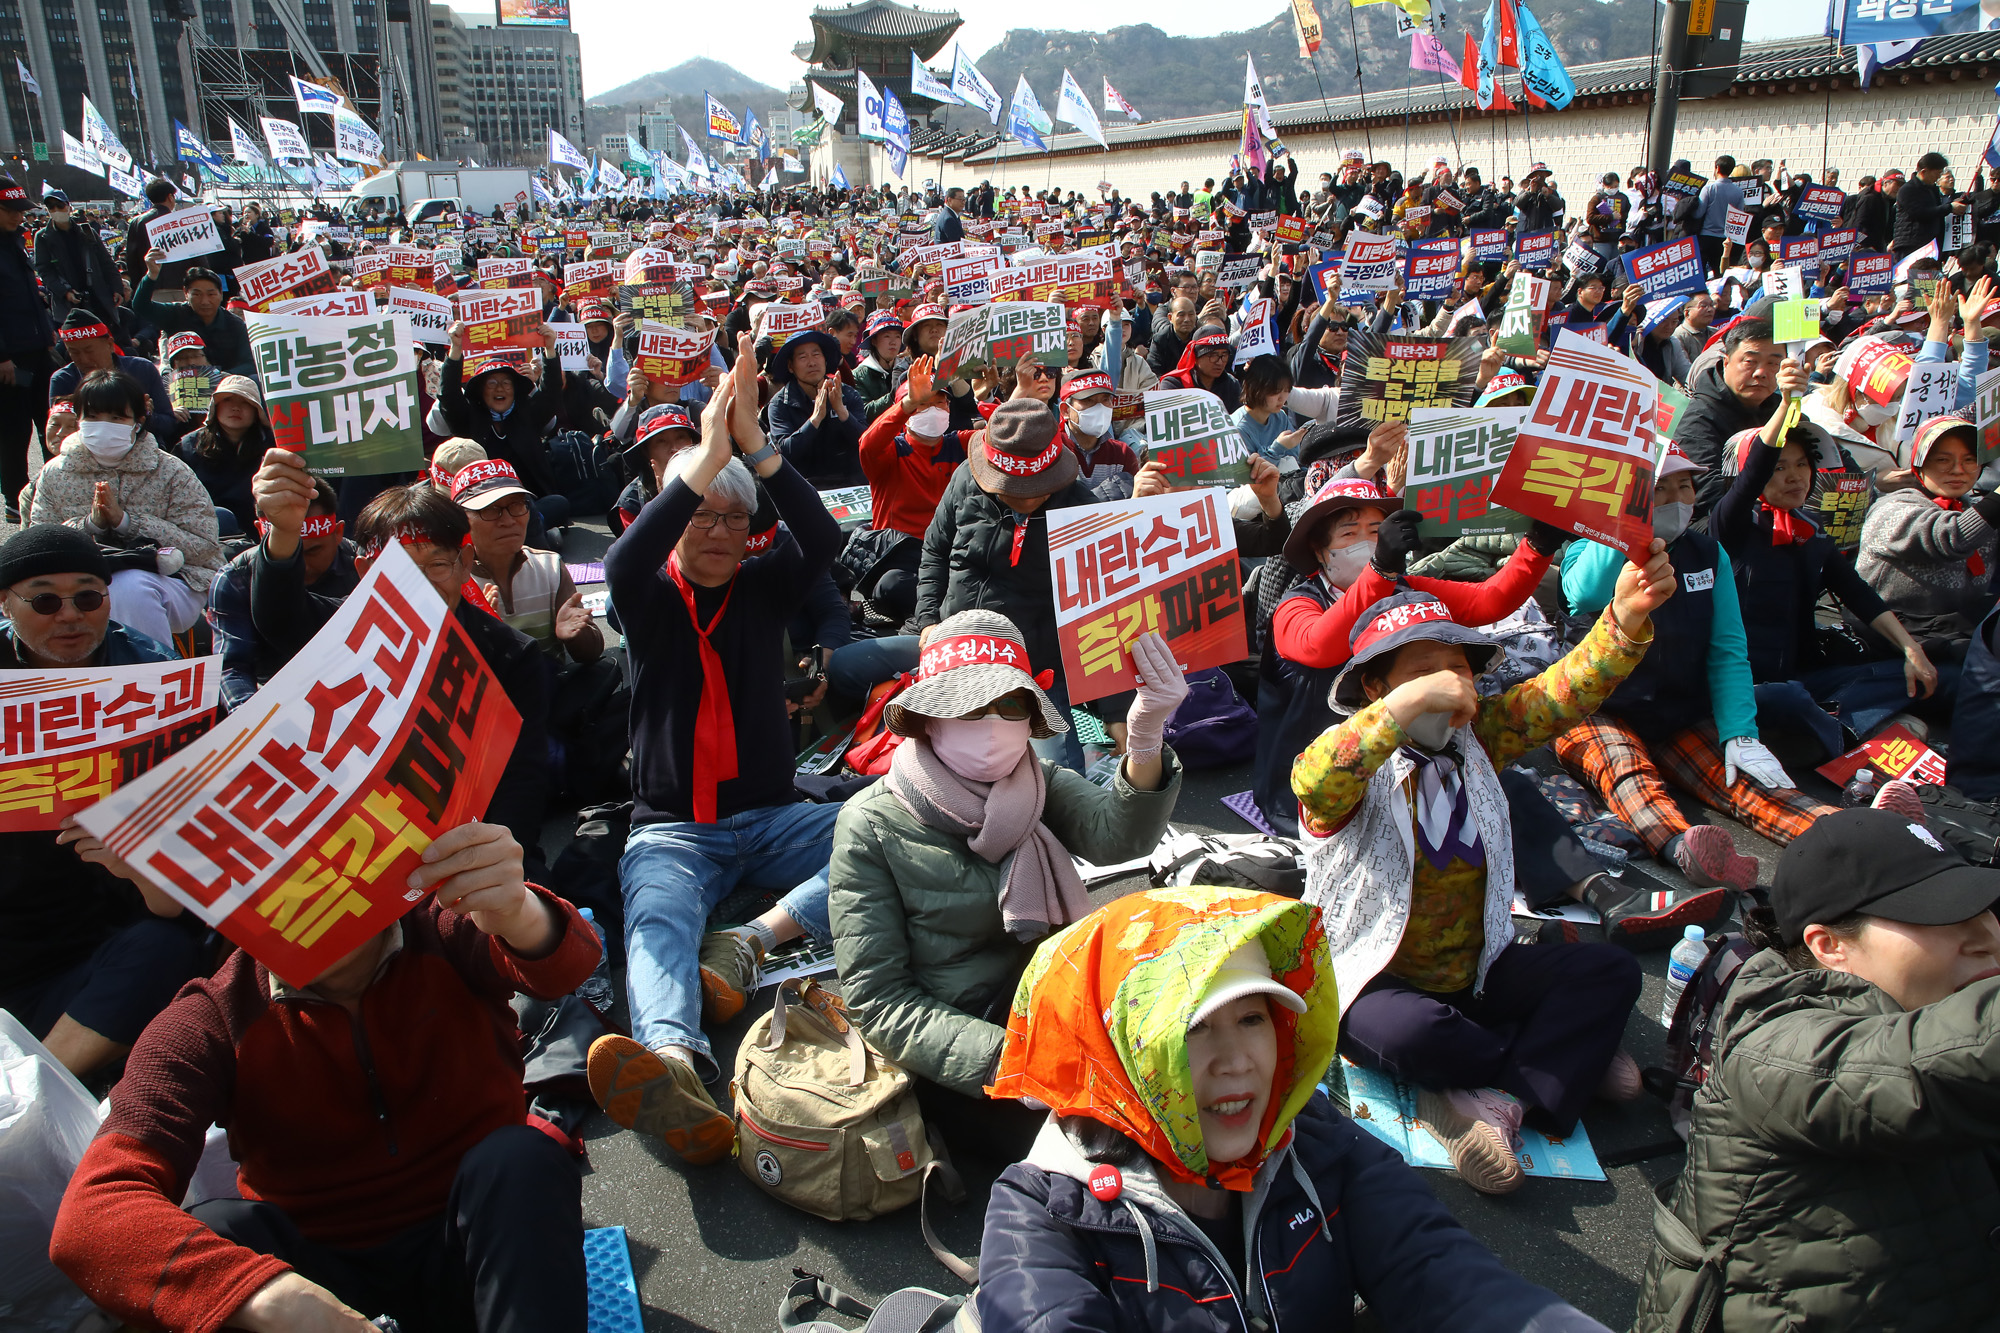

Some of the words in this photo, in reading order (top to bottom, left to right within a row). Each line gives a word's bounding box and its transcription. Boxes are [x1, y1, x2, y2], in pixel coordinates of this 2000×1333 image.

[1808, 189, 1842, 203] 윤석열을
[1406, 208, 1430, 220] 내란수괴
[1799, 202, 1841, 216] 파면하라!
[150, 220, 179, 236] 내란동조
[1036, 223, 1062, 235] 내란수괴
[1284, 219, 1301, 230] 윤석열
[593, 233, 628, 247] 내란농정
[1475, 232, 1505, 244] 윤석열을
[1522, 237, 1551, 250] 윤석열을
[1823, 231, 1854, 247] 윤석열을
[390, 249, 434, 267] 내란수괴
[921, 243, 960, 263] 내란수괴
[1519, 248, 1551, 264] 파면하라!
[1637, 244, 1693, 275] 윤석열을
[1819, 244, 1855, 260] 파면하라!
[480, 259, 528, 279] 내란수괴
[565, 262, 608, 284] 내란수괴
[674, 264, 703, 277] 란수괴
[1027, 263, 1058, 284] 내란
[1060, 260, 1111, 283] 내란수괴
[1415, 254, 1458, 274] 윤석열을
[1855, 256, 1891, 274] 윤석열을
[243, 251, 321, 301] 내란수괴
[484, 272, 532, 289] 즉각파면
[779, 279, 802, 290] 란수괴
[990, 269, 1025, 294] 내란수
[1220, 268, 1259, 281] 수사하라!
[1640, 258, 1699, 296] 파면하라!
[1851, 272, 1892, 290] 파면하라!
[568, 278, 613, 296] 즉각파면
[393, 297, 426, 310] 내란동조
[462, 293, 536, 322] 내란수괴
[632, 294, 683, 310] 윤석열을
[768, 304, 826, 330] 내란수괴
[990, 306, 1061, 337] 내란농정
[1547, 314, 1567, 326] 석열을
[469, 313, 541, 344] 즉각파면
[943, 306, 991, 356] 내란농정
[641, 331, 716, 357] 내란수괴
[992, 331, 1065, 360] 박살내자
[1390, 344, 1438, 358] 내란수괴
[1366, 357, 1462, 382] 윤석열을
[270, 380, 416, 452] 살내자
[1532, 375, 1657, 462] 내란수
[992, 442, 1059, 475] 식량주권사수
[1414, 422, 1518, 476] 내란농
[822, 484, 872, 508] 란농정
[1417, 476, 1500, 524] 박살
[1056, 494, 1221, 613] 내란수괴
[1078, 557, 1240, 677] 즉각파면
[147, 571, 431, 907] 내란수괴
[256, 626, 489, 948] 즉각파면
[1092, 1174, 1117, 1192] 탄핵
[1288, 1208, 1315, 1230] FILA
